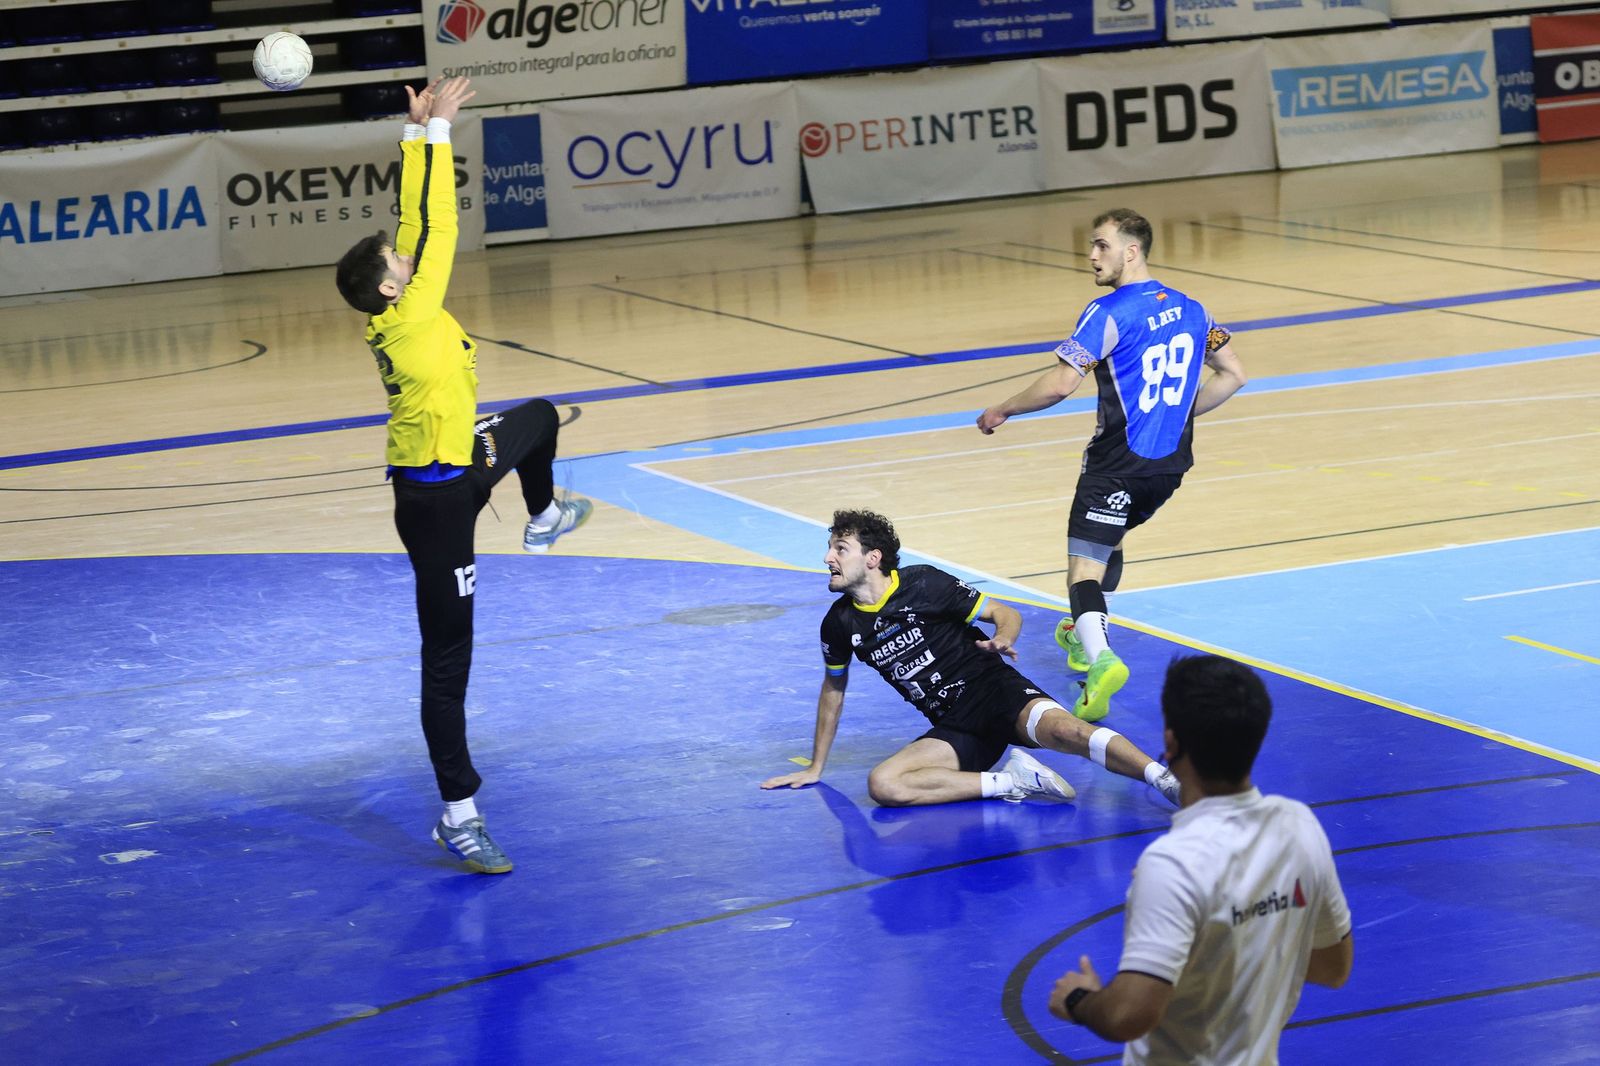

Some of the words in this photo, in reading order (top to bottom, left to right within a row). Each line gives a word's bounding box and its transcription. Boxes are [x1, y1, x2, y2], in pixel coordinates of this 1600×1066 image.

[487, 0, 668, 48] algetoner
[739, 14, 801, 28] Queremos
[803, 10, 836, 22] verte
[442, 59, 517, 79] suministro
[519, 52, 573, 74] integral
[576, 51, 609, 69] para
[612, 46, 625, 62] la
[627, 44, 677, 62] oficina
[1299, 63, 1483, 109] REMESA
[1065, 79, 1237, 151] DFDS
[482, 160, 544, 184] Ayunta
[567, 120, 773, 189] ocyru
[227, 155, 469, 207] OKEYMS
[229, 205, 373, 230] FITNESS
[1138, 332, 1194, 414] 89
[454, 564, 477, 597] 12
